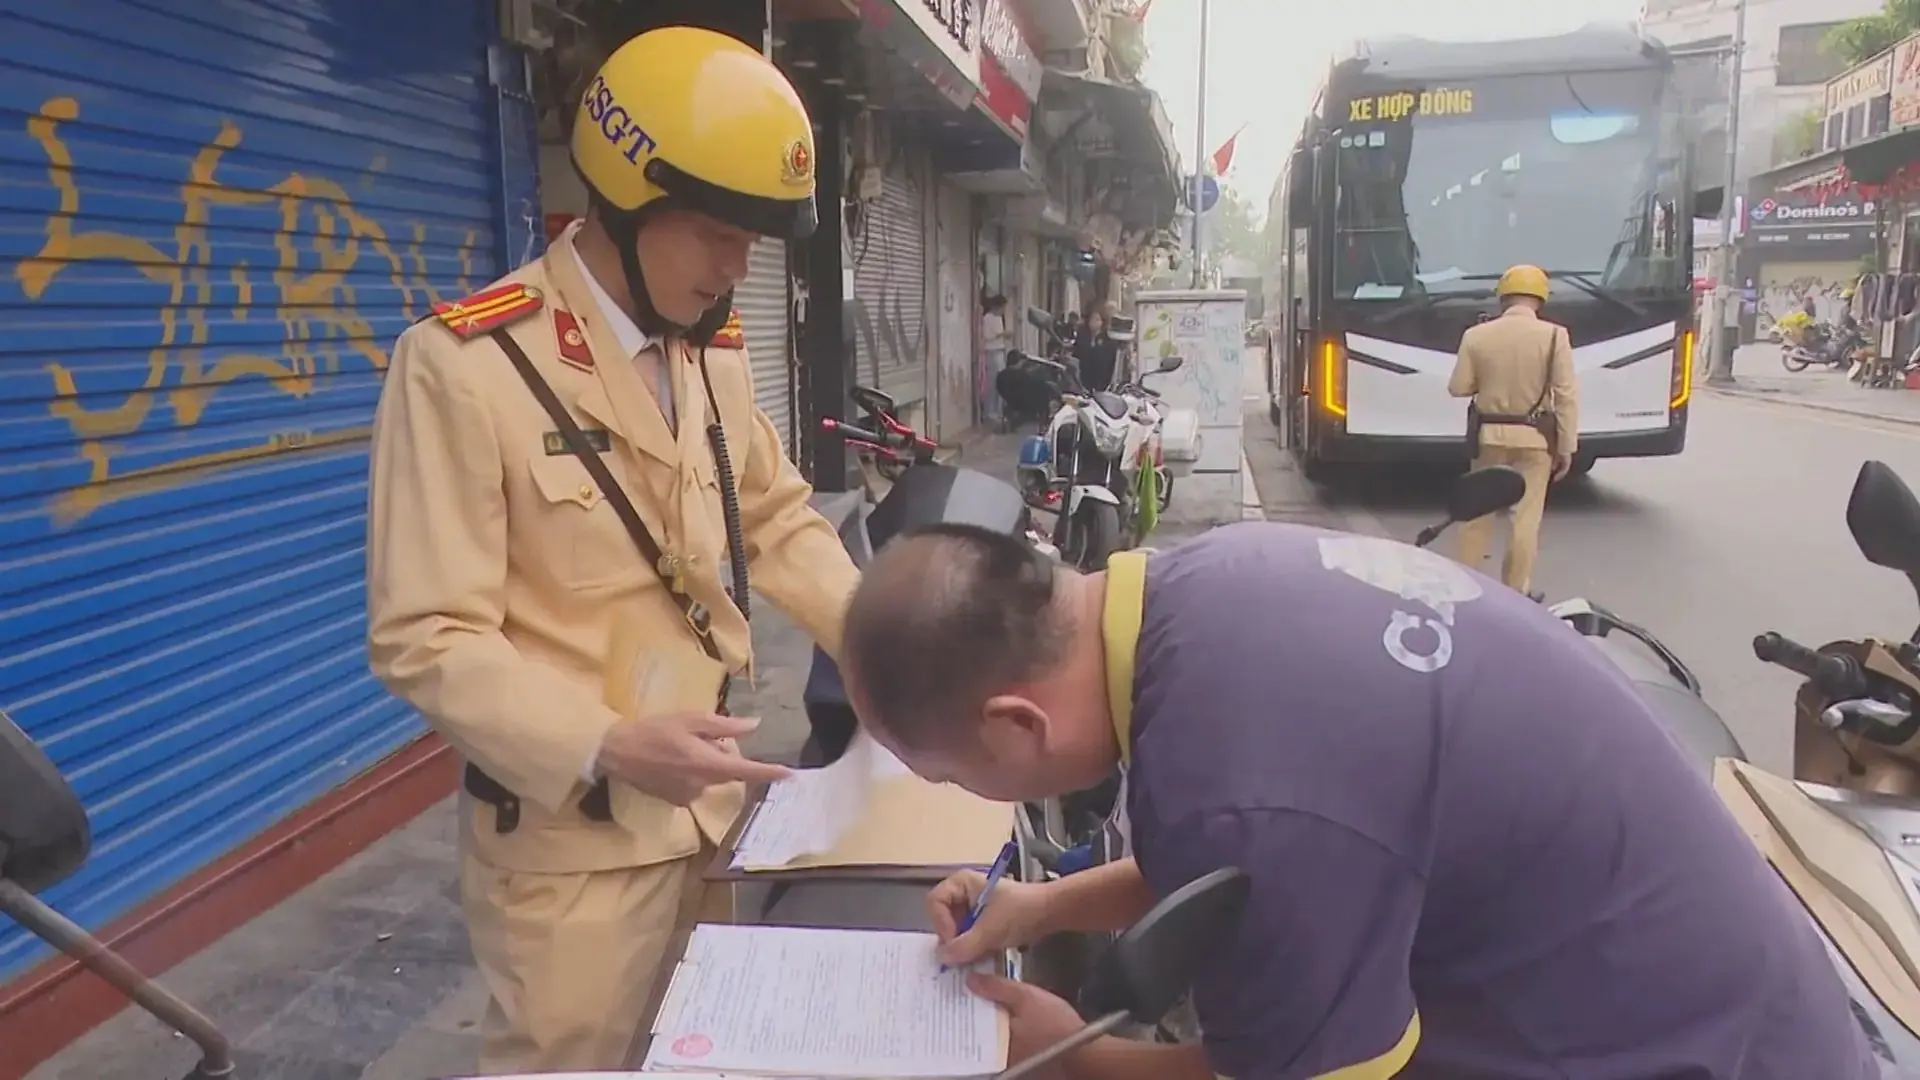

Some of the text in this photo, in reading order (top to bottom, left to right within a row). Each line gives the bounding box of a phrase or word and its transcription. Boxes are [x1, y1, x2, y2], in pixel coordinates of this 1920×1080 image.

[584, 76, 656, 165] CSGT
[1349, 98, 1372, 121] XE
[1377, 92, 1414, 121] HỢP
[1777, 201, 1859, 219] Domino's
